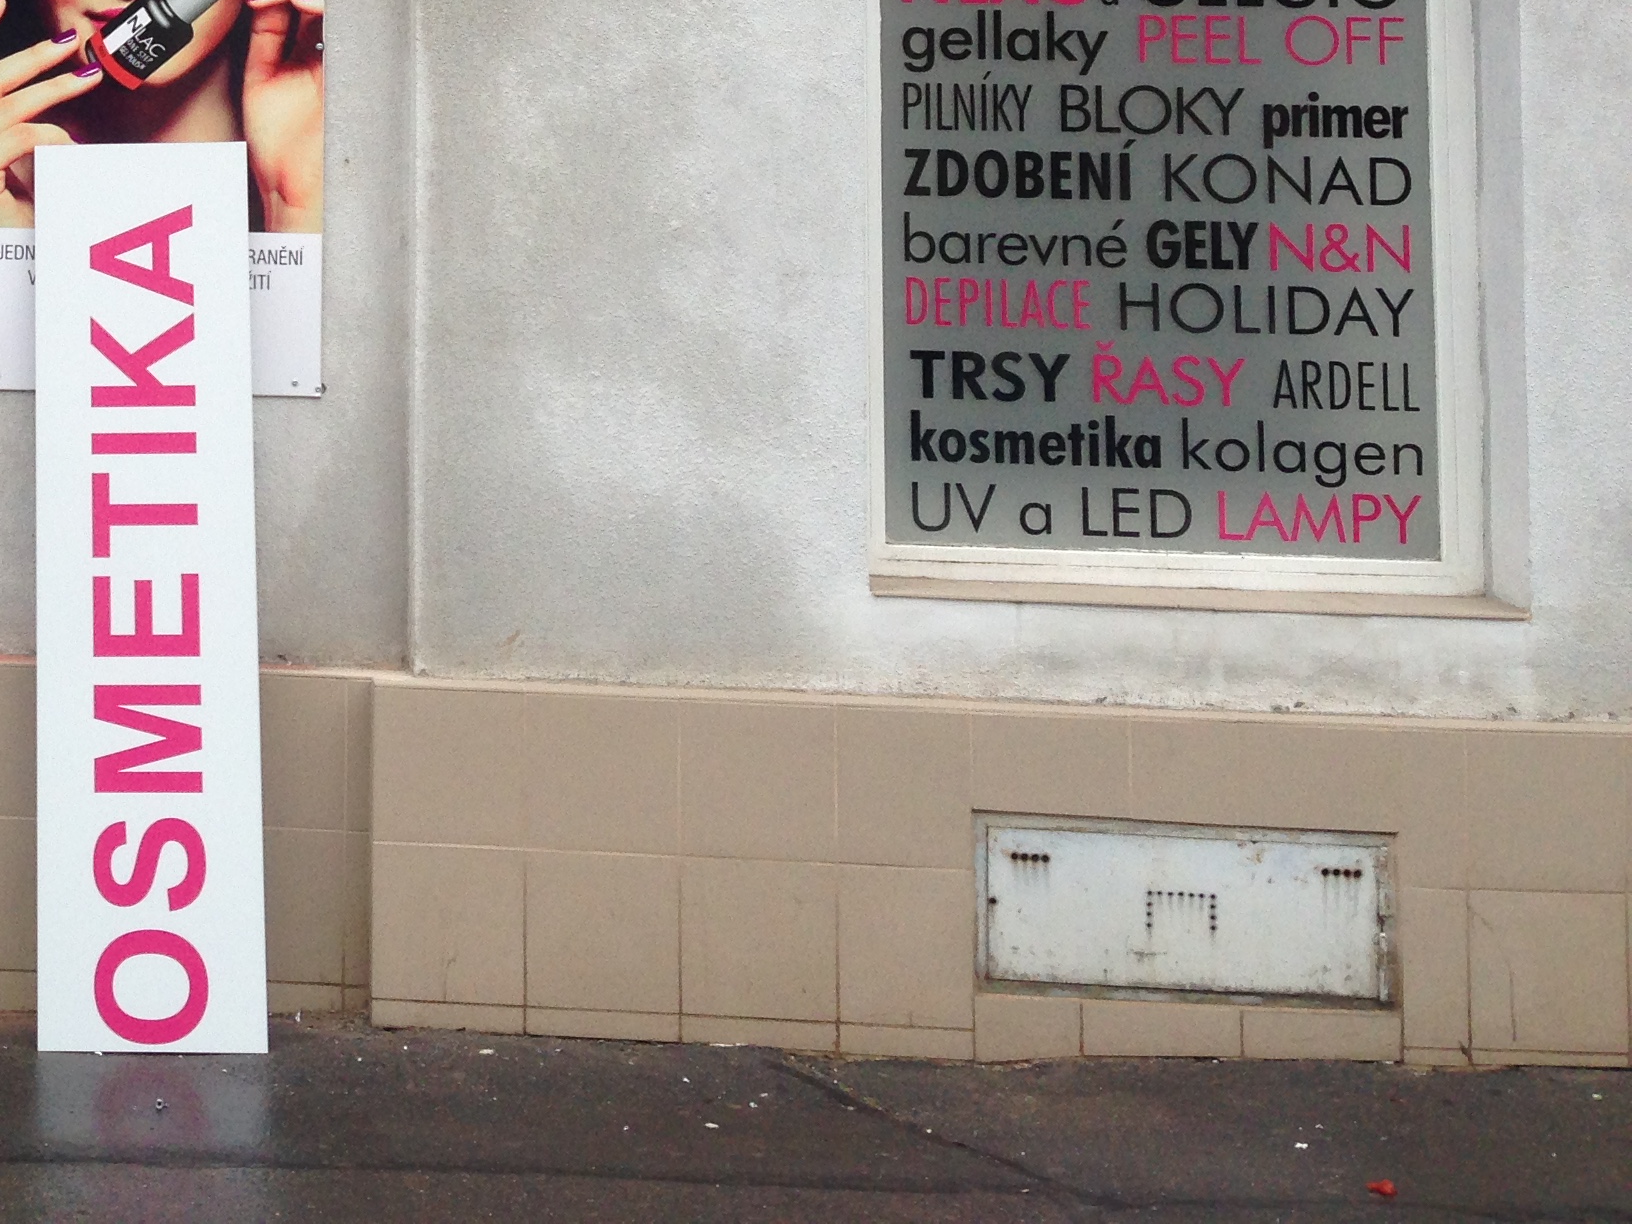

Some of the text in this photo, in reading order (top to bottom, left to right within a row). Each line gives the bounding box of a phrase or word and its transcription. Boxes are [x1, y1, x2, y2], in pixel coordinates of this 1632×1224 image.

[127, 14, 166, 58] NLAC
[902, 10, 1404, 78] gellaky PEEL OFF
[900, 71, 1408, 149] PILNÍKY BLOKY primer
[903, 138, 1411, 205] ZDOBENÍ KONAD
[248, 245, 304, 266] RANĚNÍ
[904, 212, 1410, 272] barevné GELY N&N
[248, 269, 272, 291] ITÍ
[906, 277, 1414, 337] DEPILACE HOLIDAY
[910, 342, 1420, 411] TRSY ŘASY ARDELL
[911, 410, 1422, 487] kosmetika kolagen
[912, 482, 1421, 544] UV a LED LAMPY
[91, 206, 208, 1044] OSMETIKA
